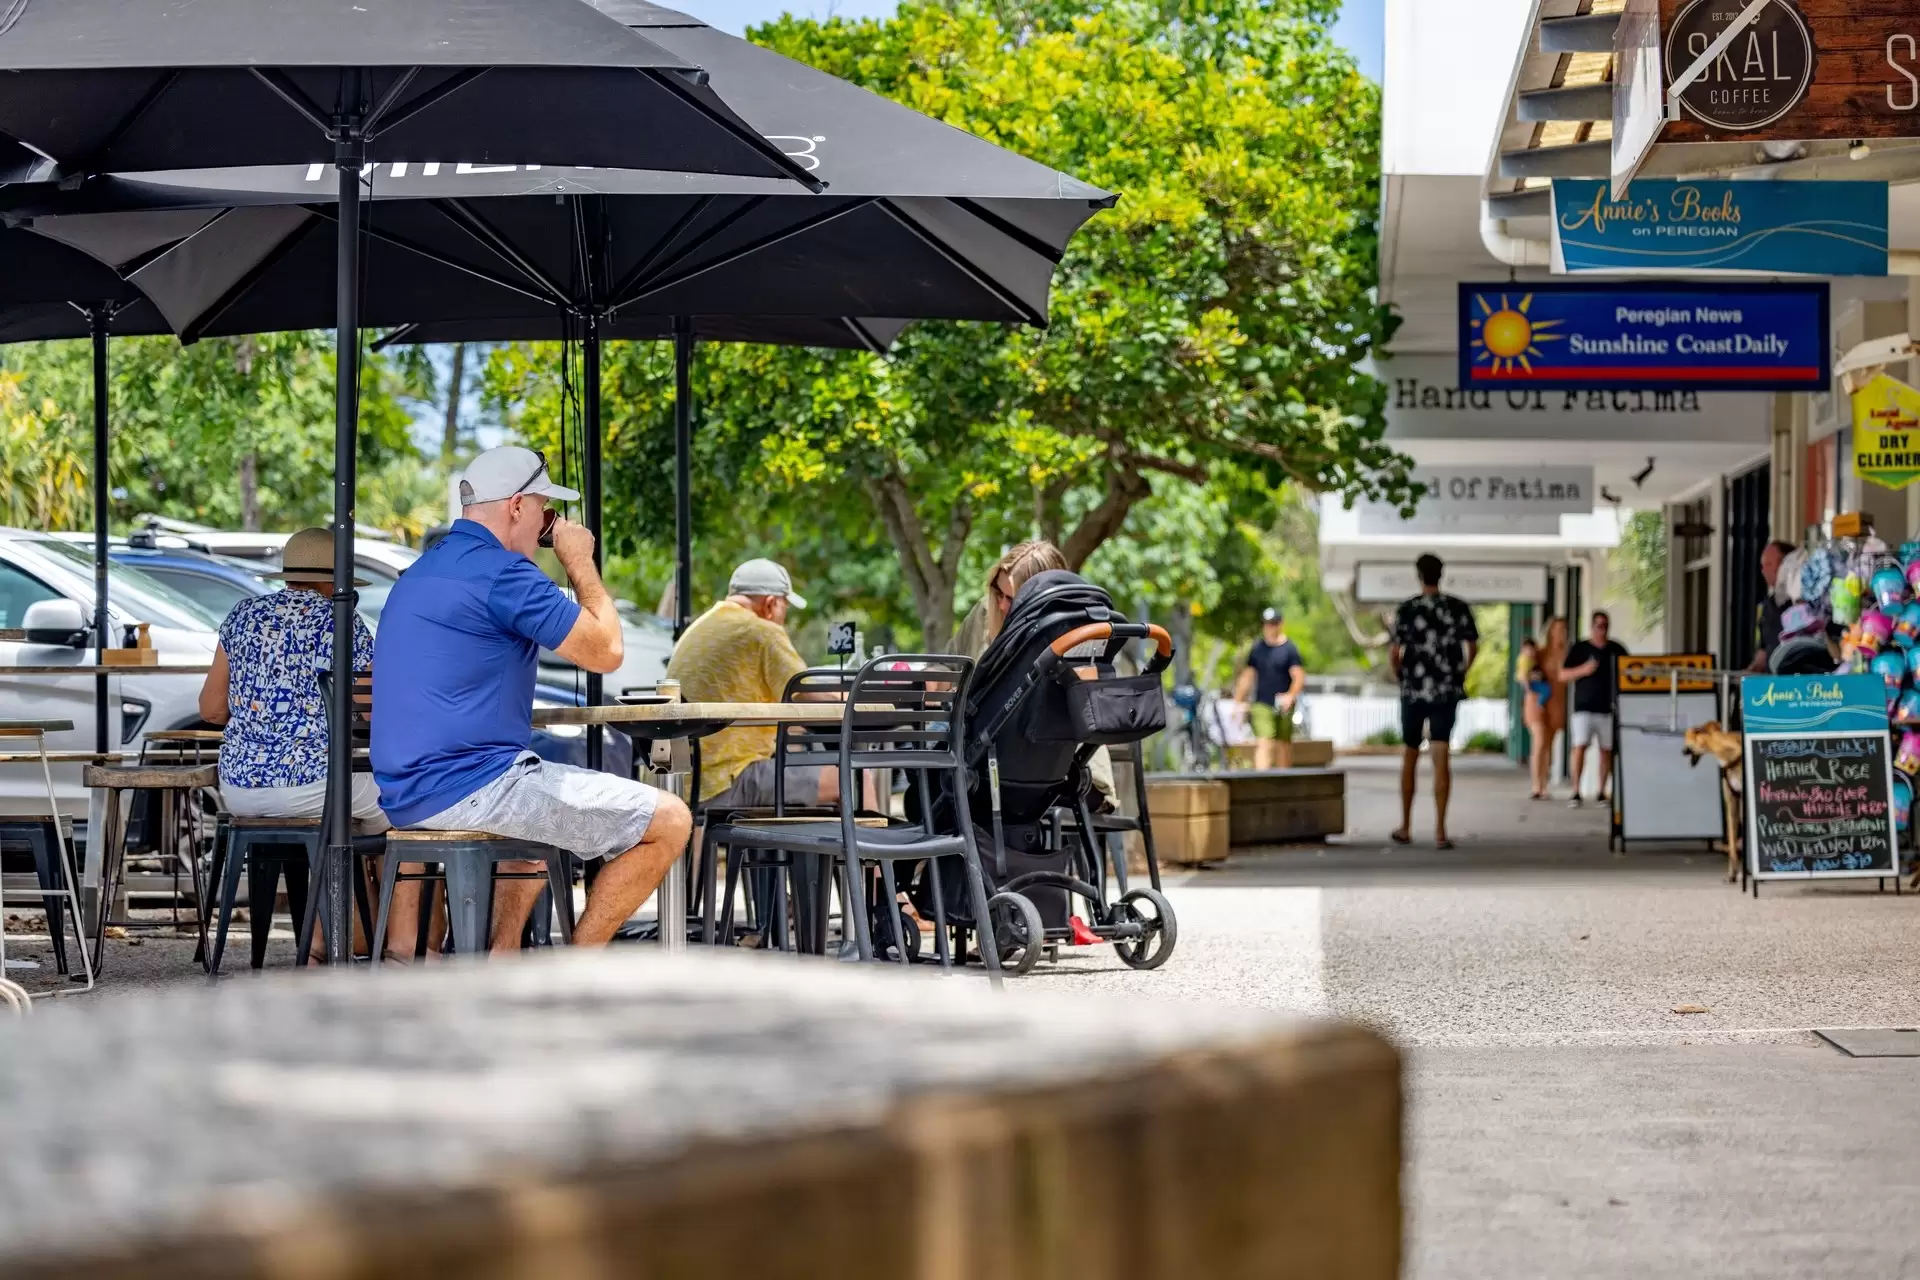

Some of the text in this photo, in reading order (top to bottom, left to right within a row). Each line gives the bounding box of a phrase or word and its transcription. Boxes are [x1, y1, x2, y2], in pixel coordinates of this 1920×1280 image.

[1710, 88, 1770, 104] COFFEE
[1560, 184, 1741, 233] Annie's Books
[1632, 226, 1738, 236] on PEREGIAN
[1615, 306, 1743, 327] Peregian News
[1569, 333, 1669, 355] Sunshine
[1394, 378, 1492, 410] Hand
[1879, 434, 1909, 449] DRY
[1449, 475, 1482, 501] Of
[1487, 475, 1580, 501] Fatima
[1004, 686, 1023, 711] ROVER
